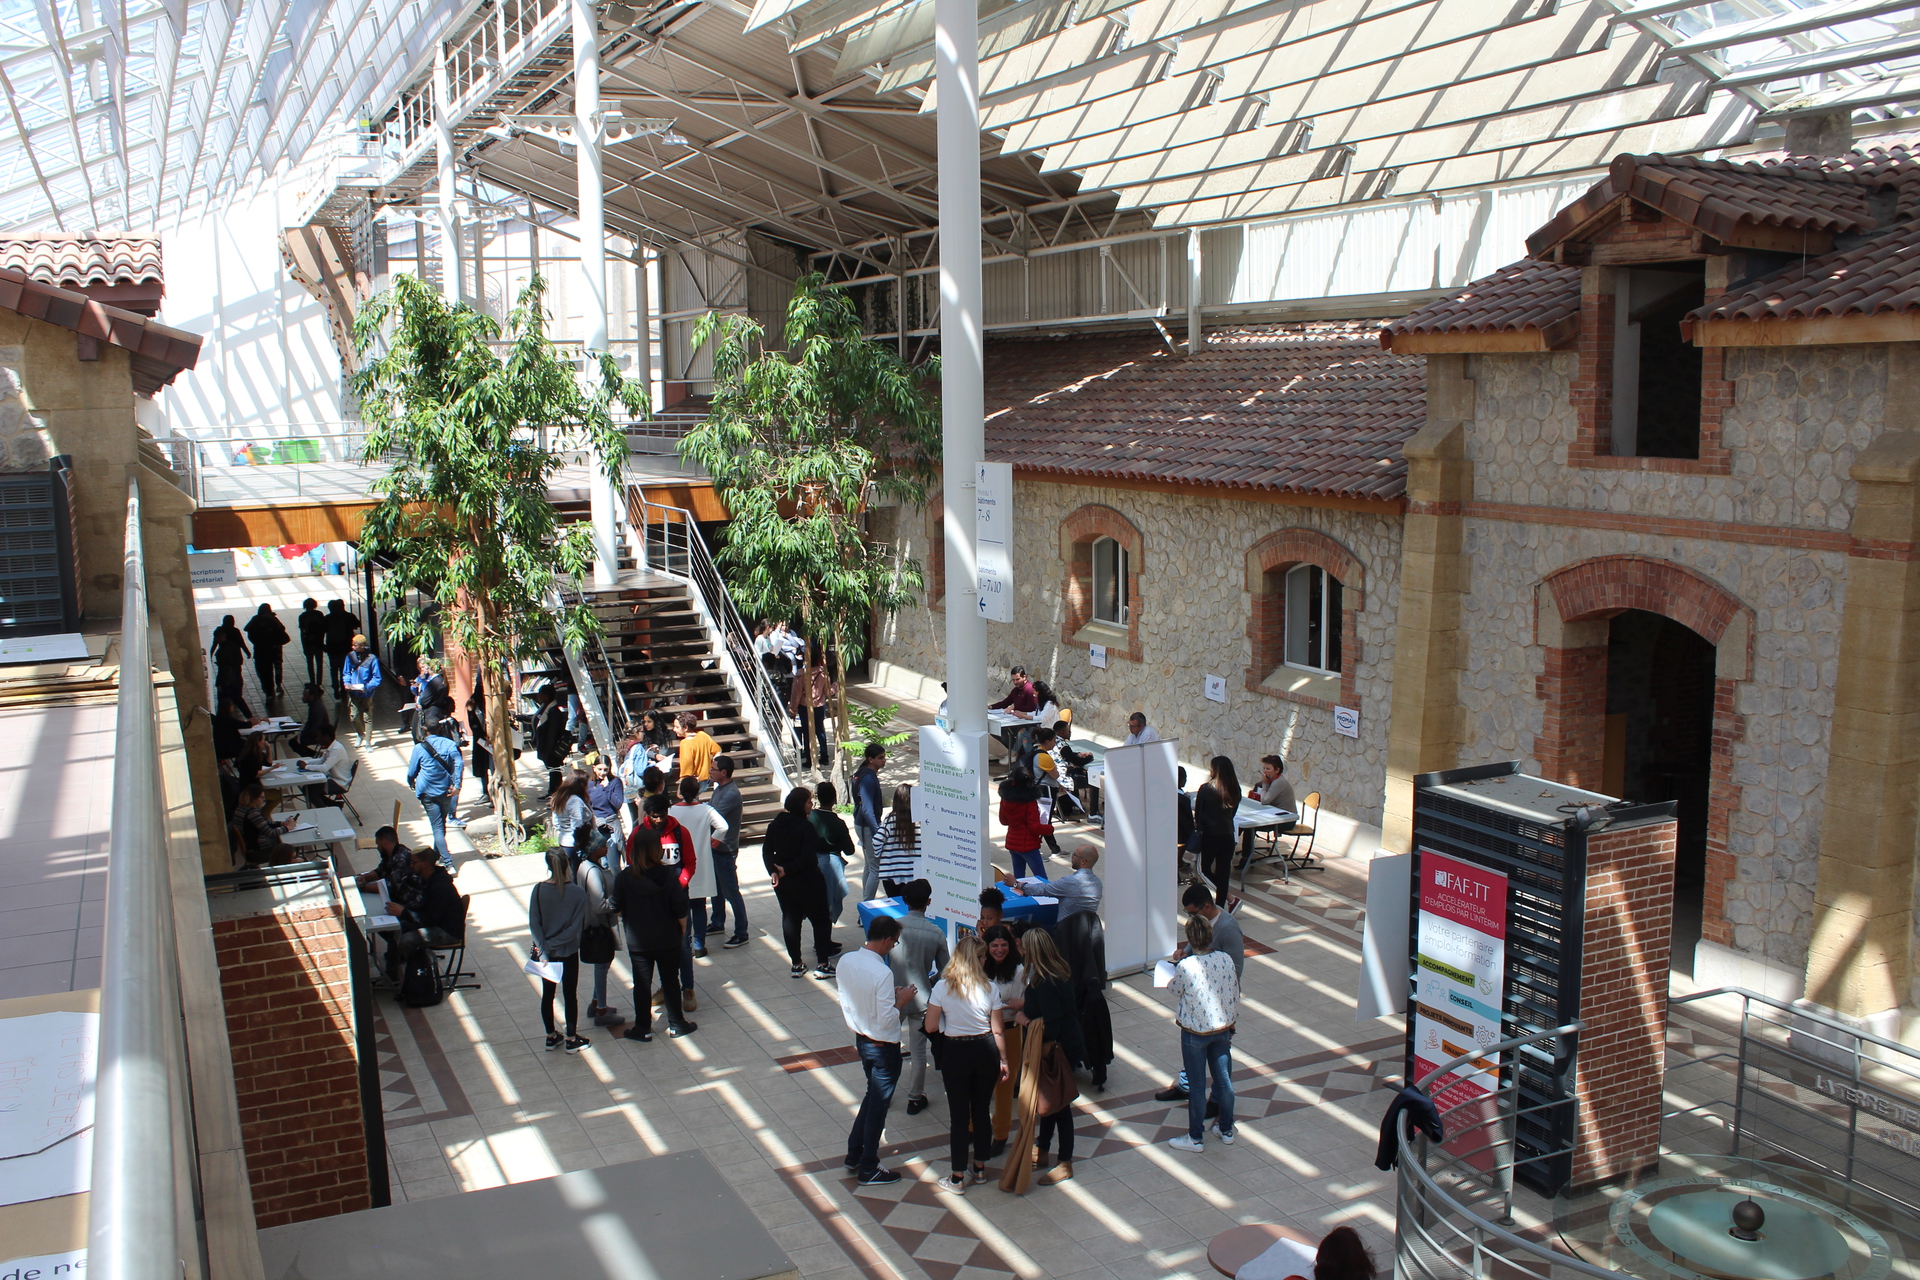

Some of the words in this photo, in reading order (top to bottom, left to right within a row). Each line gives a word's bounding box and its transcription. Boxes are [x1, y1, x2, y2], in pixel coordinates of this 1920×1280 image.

[977, 497, 996, 506] bâtiments
[190, 568, 225, 576] nscriptions
[978, 566, 996, 576] bâtiments
[191, 576, 224, 584] ecrétariat
[941, 763, 962, 772] formation
[942, 785, 963, 795] formation
[940, 807, 958, 816] Bureaux
[936, 830, 953, 839] Bureaux
[953, 835, 977, 845] formateurs
[949, 825, 966, 834] Bureaux
[966, 829, 976, 837] CME
[957, 844, 977, 854] Direction
[927, 854, 951, 864] Inscriptions
[954, 860, 977, 871] Secrétariat
[950, 851, 977, 862] Informatique
[934, 871, 949, 880] Centre
[954, 877, 977, 888] ressources
[1446, 871, 1491, 902] FAF.TT
[946, 890, 955, 898] Mur
[955, 893, 977, 904] d'escalade
[1437, 892, 1486, 915] ACCÉLÉRATEUR
[950, 907, 961, 915] Salle
[1424, 895, 1456, 914] D'EMPLOIS
[1456, 907, 1470, 919] PAR
[1469, 913, 1500, 930] L'INTÉRIM
[1427, 920, 1451, 938] Votre
[1451, 931, 1494, 955] partenaire
[1424, 934, 1497, 971] emploi-formation
[1422, 959, 1474, 985] ACCOMPAGNEMENT
[1449, 994, 1474, 1009] CONSEIL
[1419, 1006, 1443, 1021] PROJETS
[1443, 1016, 1473, 1035] INNOVANTS
[58, 1049, 93, 1079] PAS
